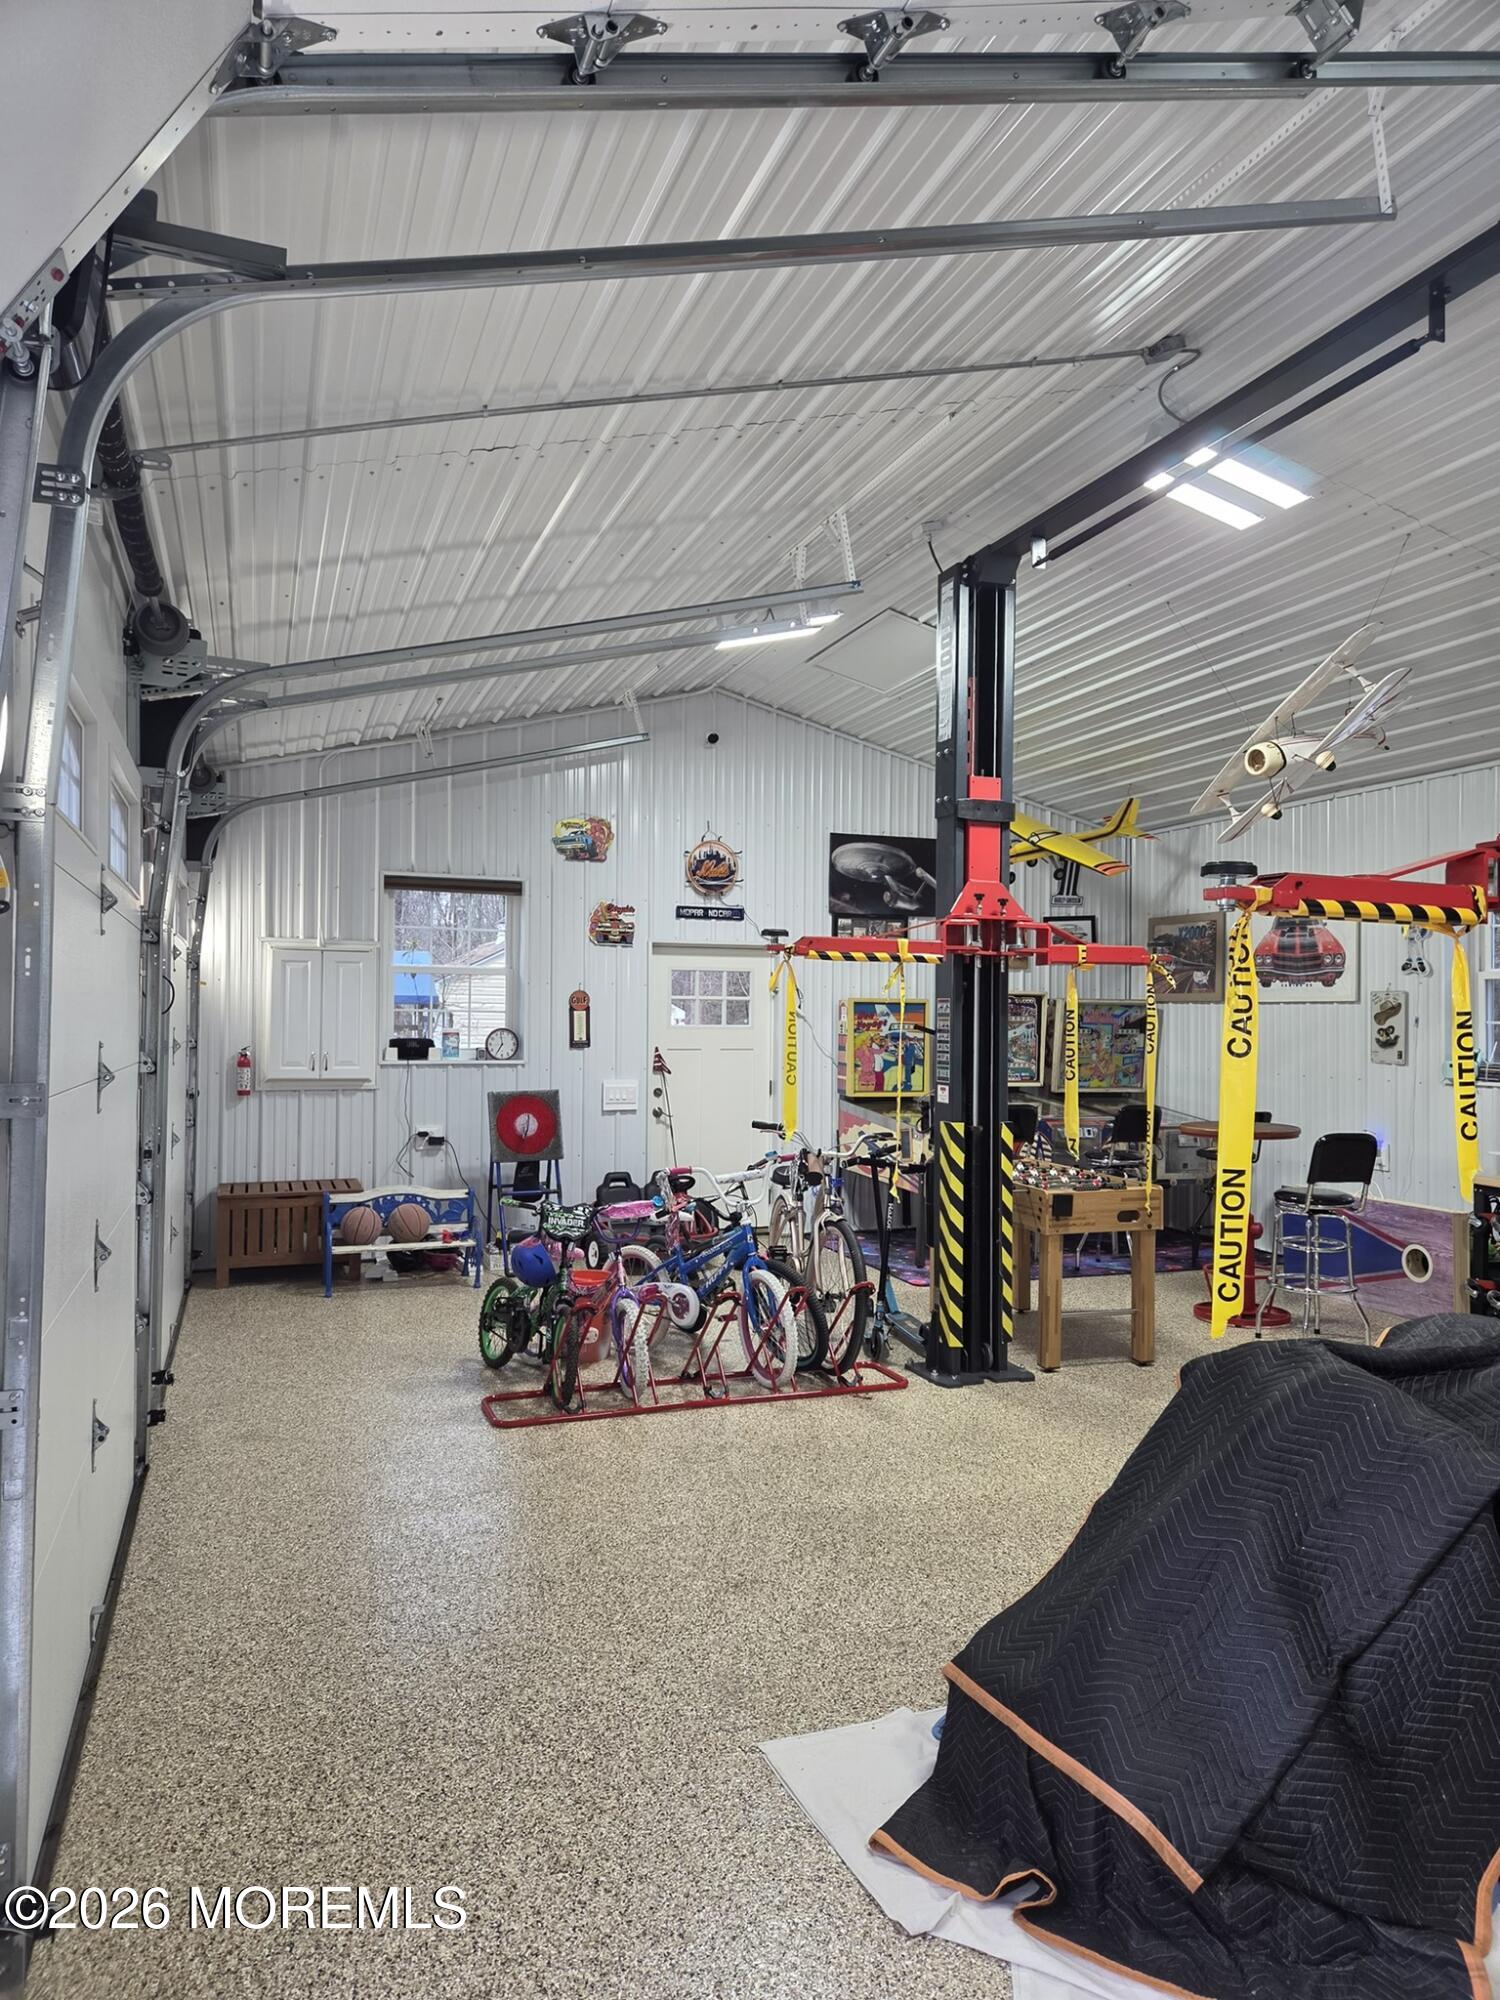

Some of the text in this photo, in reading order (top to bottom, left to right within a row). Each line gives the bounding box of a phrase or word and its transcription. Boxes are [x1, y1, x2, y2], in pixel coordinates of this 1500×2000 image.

[1065, 1009, 1076, 1081] CAUTION
[1227, 932, 1252, 1058] CAUTIO
[1456, 1011, 1478, 1141] CAUTION
[548, 1217, 585, 1228] INVADER
[1218, 1168, 1246, 1303] CAUTION
